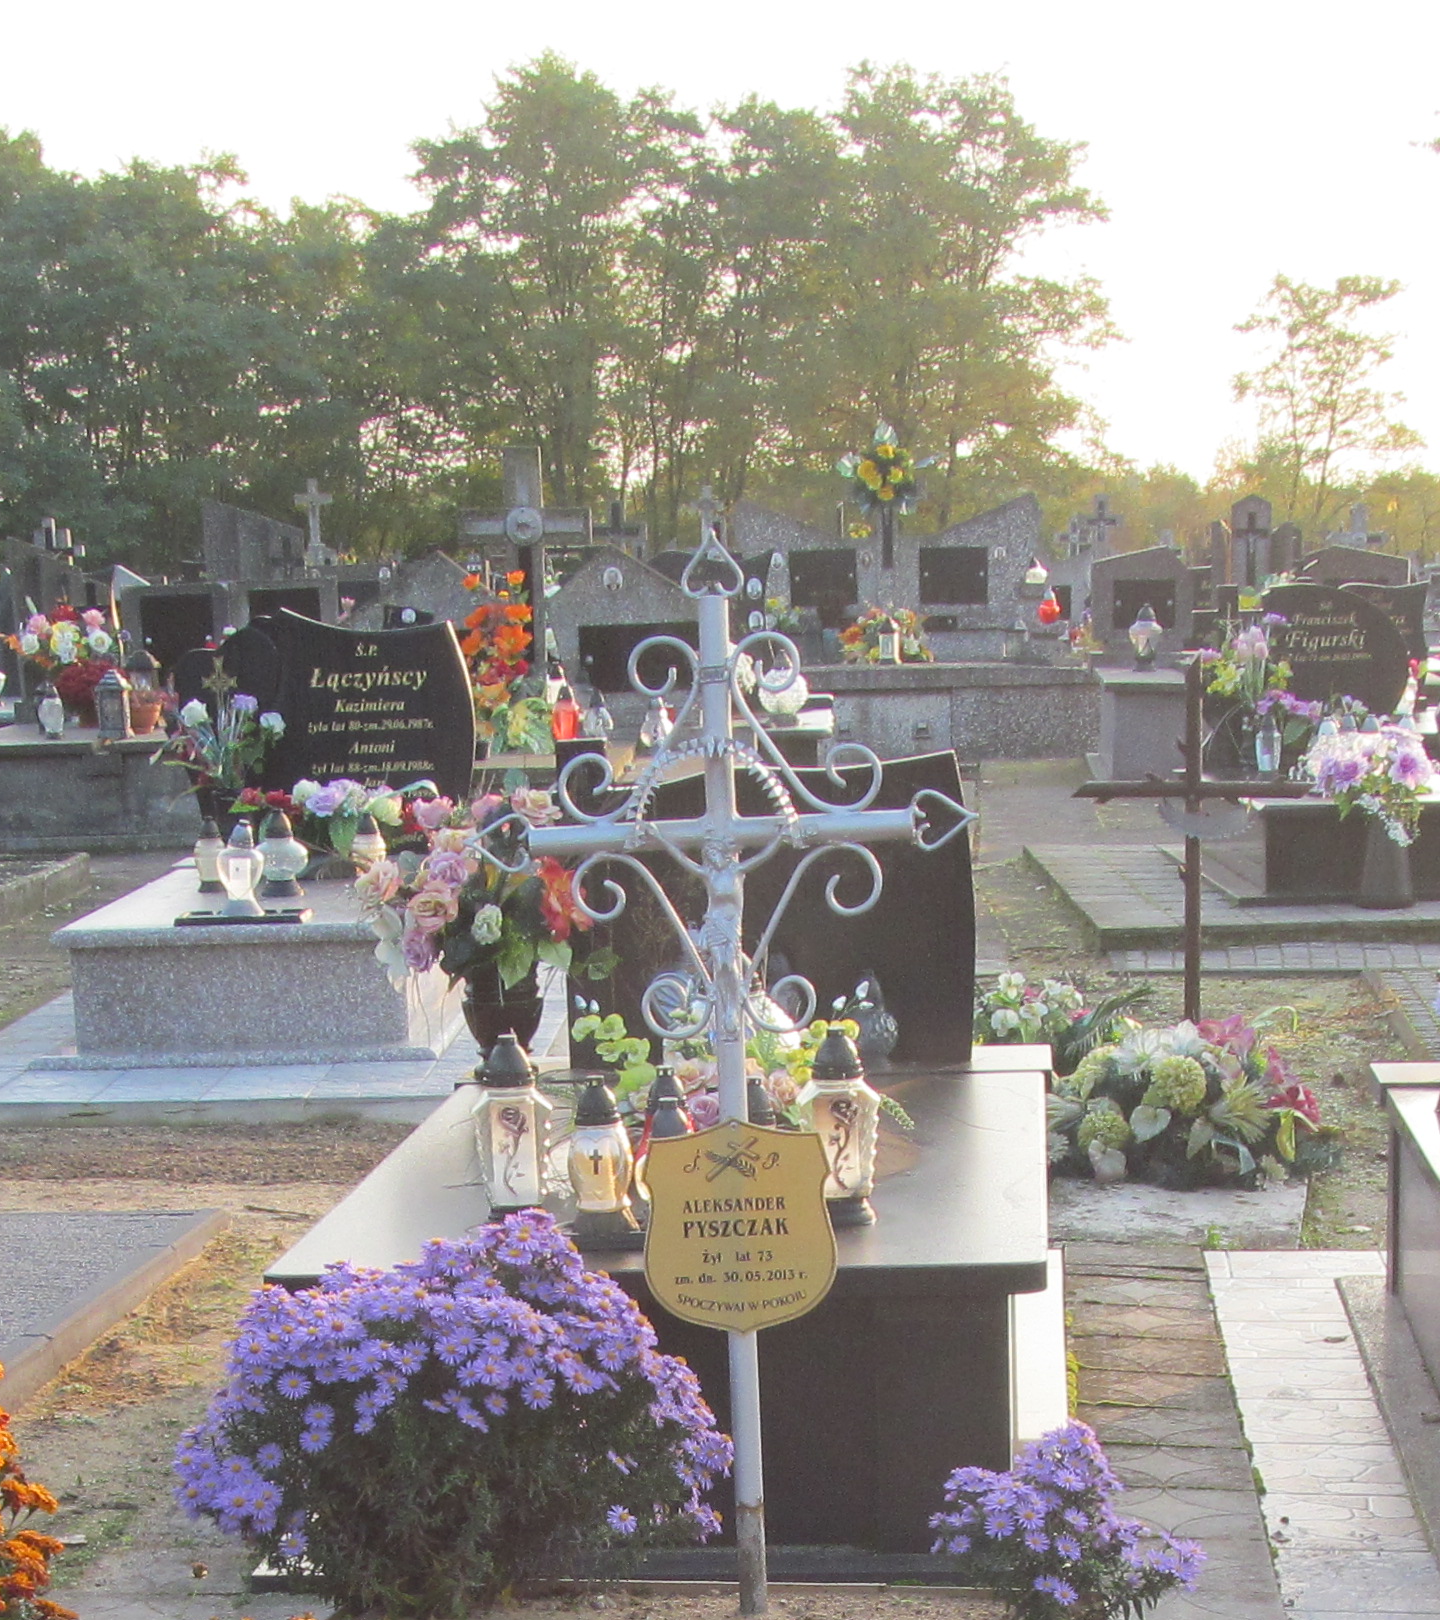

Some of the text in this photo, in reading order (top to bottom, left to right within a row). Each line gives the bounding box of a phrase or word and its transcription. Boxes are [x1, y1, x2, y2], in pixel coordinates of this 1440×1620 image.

[310, 666, 427, 692] Łączyńscy
[334, 698, 405, 713] Kazimiera
[331, 720, 345, 731] lat
[349, 740, 395, 754] Antoni
[330, 762, 344, 773] lat
[682, 1197, 786, 1214] ALEKSANDER
[682, 1217, 790, 1238] PYSZCZAK
[735, 1250, 751, 1263] lat
[756, 1250, 774, 1263] 73
[674, 1275, 694, 1286] zm.
[698, 1272, 716, 1284] dn.
[675, 1293, 745, 1312] SPOCZYWAJ
[762, 1289, 807, 1310] POKOJU
